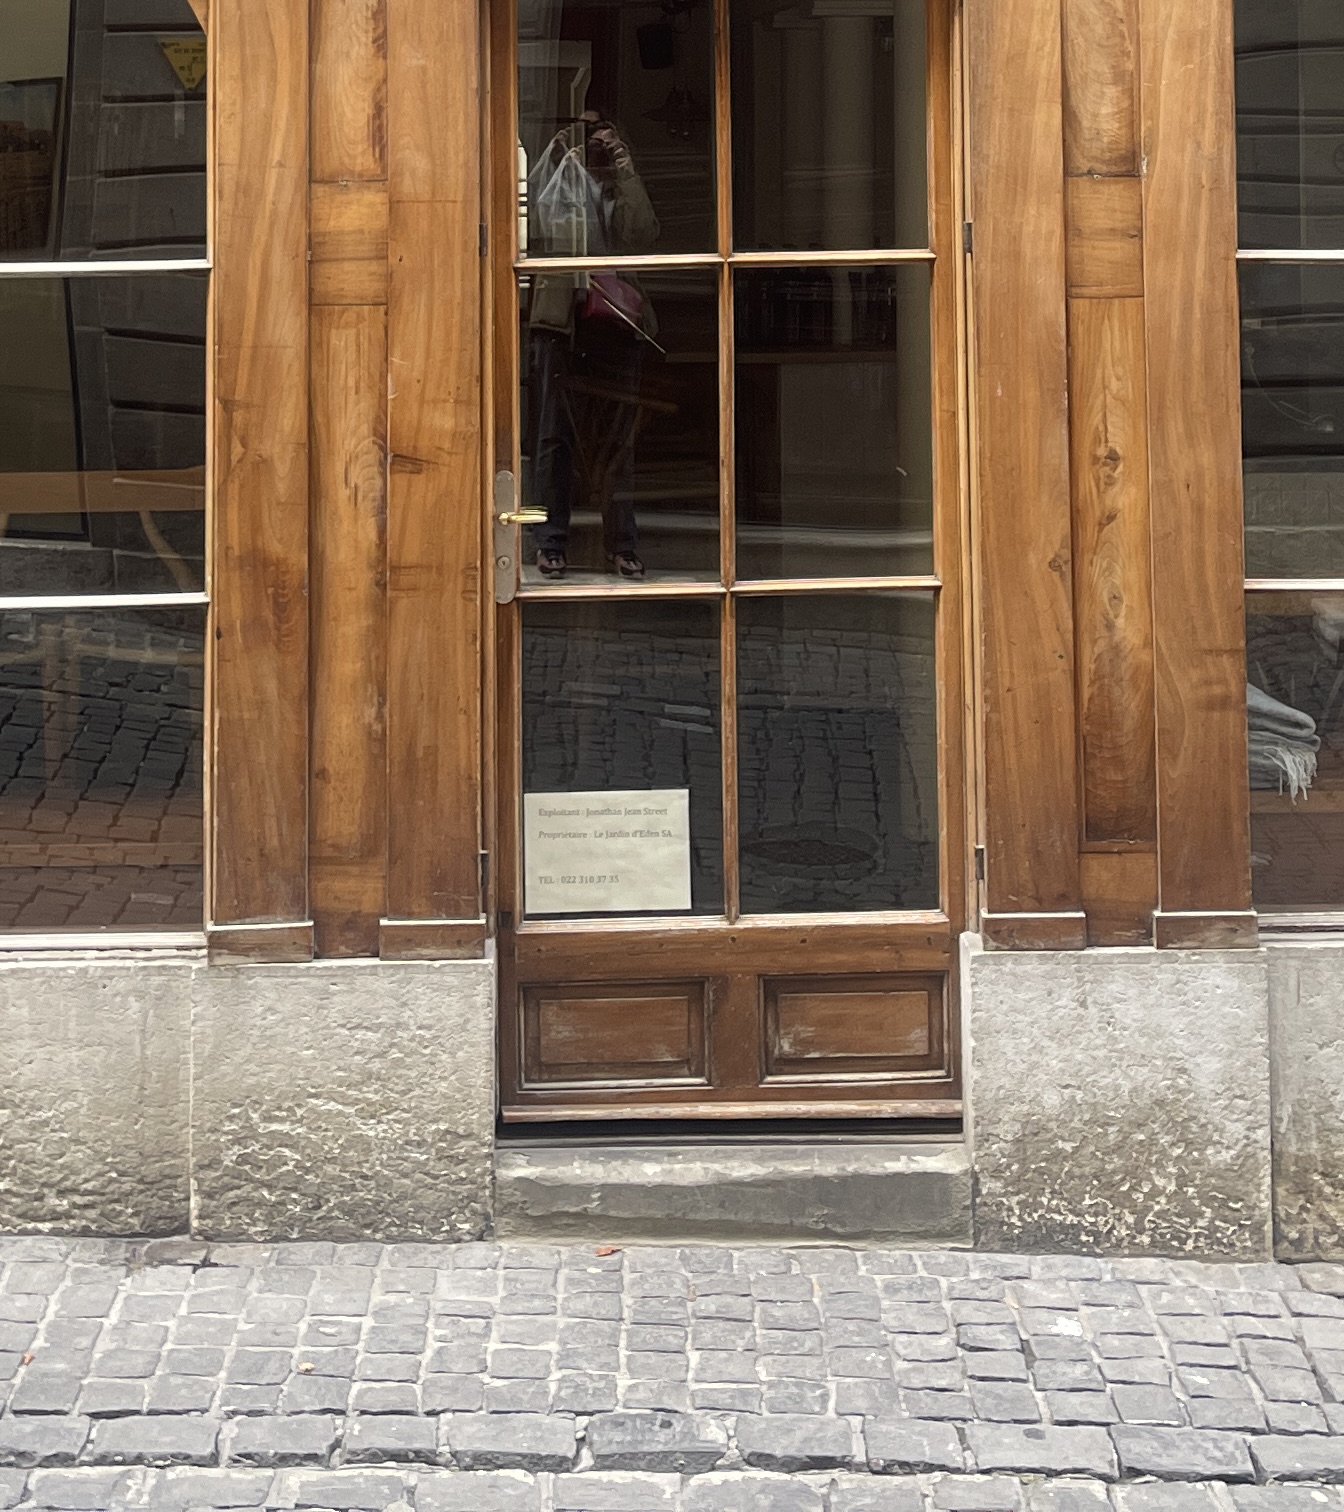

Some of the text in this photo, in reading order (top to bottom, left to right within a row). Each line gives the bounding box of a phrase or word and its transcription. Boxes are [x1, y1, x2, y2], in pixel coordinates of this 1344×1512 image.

[538, 807, 668, 818] Exploitant Jonathan Jean Street
[594, 830, 604, 838] Le
[606, 829, 630, 839] Jardin
[661, 829, 673, 838] SA
[561, 875, 577, 884] 022
